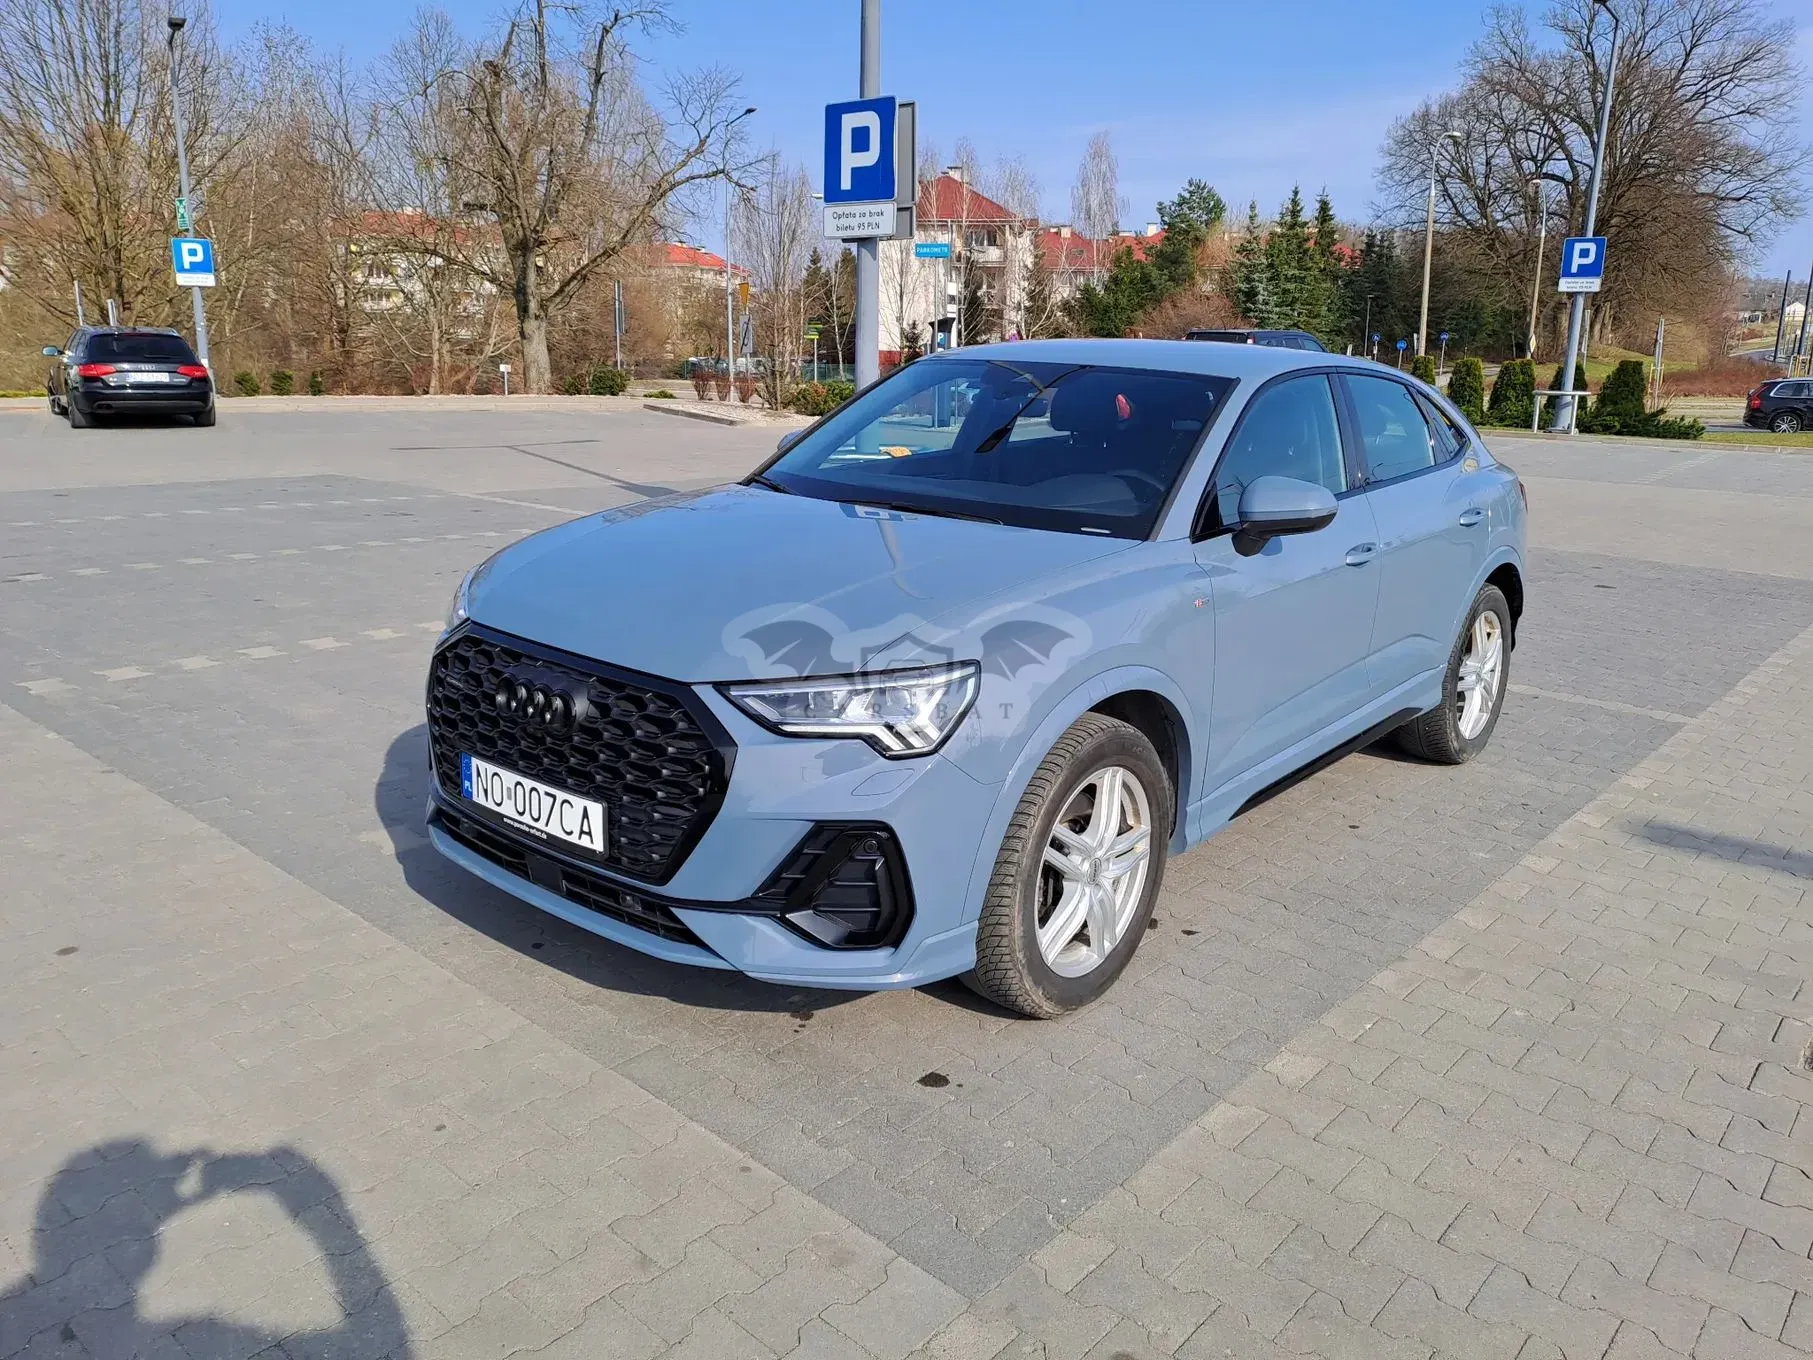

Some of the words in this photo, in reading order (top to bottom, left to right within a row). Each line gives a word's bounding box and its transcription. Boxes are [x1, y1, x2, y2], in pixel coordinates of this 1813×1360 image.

[841, 111, 880, 190] P
[868, 208, 885, 218] brak
[836, 223, 855, 231] biletu
[857, 222, 866, 231] 95
[867, 221, 880, 230] PLN
[181, 242, 204, 269] P
[1571, 242, 1596, 273] P
[937, 332, 944, 342] P
[464, 779, 473, 791] PL
[476, 763, 504, 807] NO
[513, 781, 594, 845] 007CA
